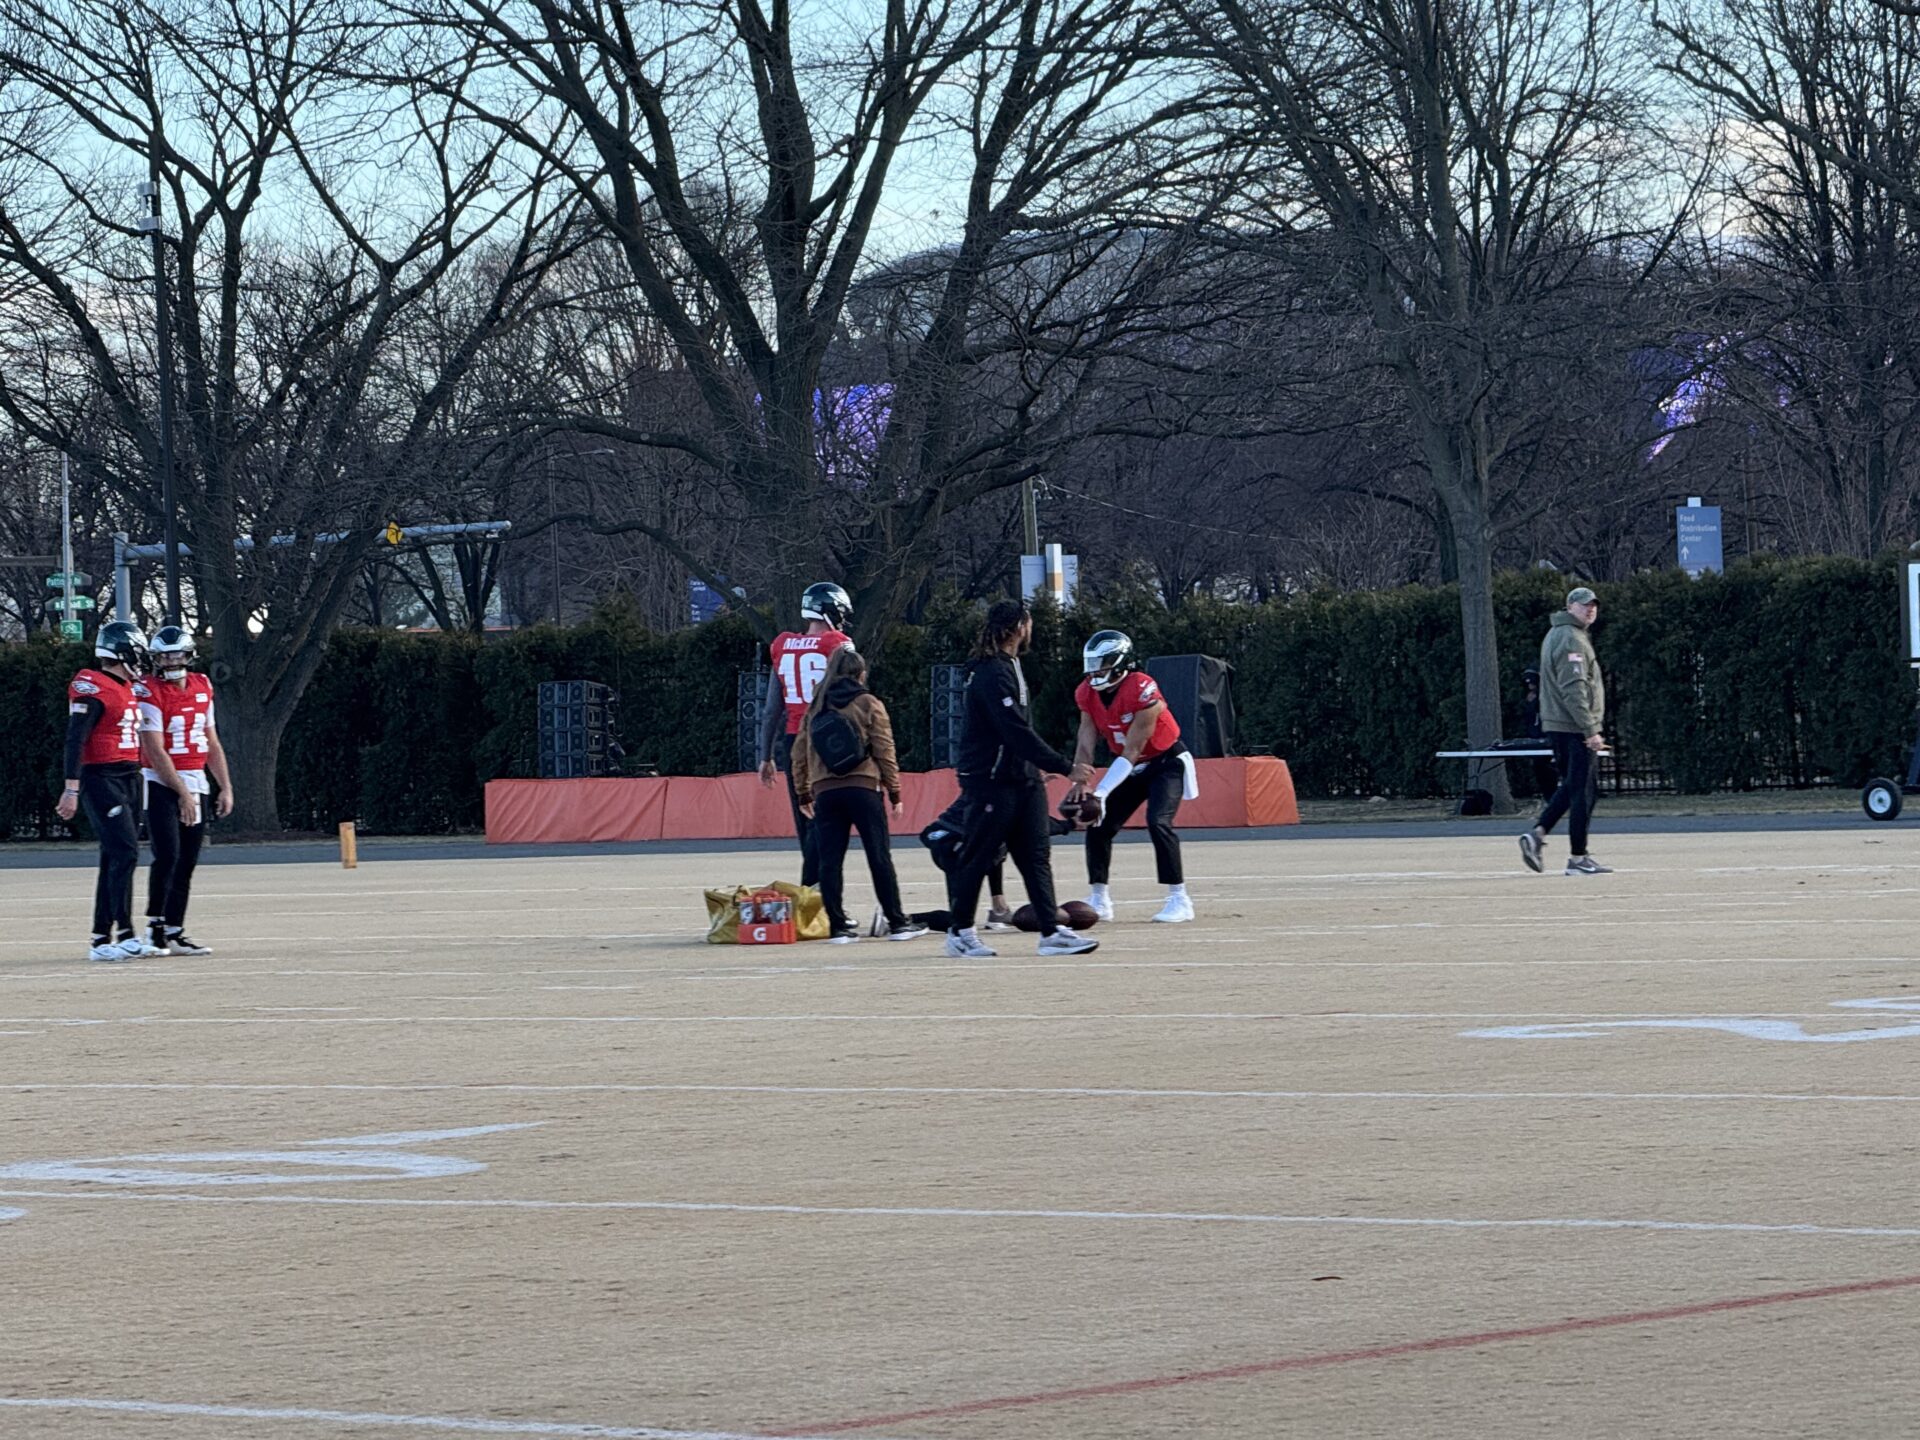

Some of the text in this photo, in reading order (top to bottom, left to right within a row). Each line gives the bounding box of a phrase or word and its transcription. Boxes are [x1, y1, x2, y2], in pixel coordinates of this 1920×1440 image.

[778, 652, 828, 704] 16
[166, 712, 209, 755] 14
[753, 927, 767, 942] G
